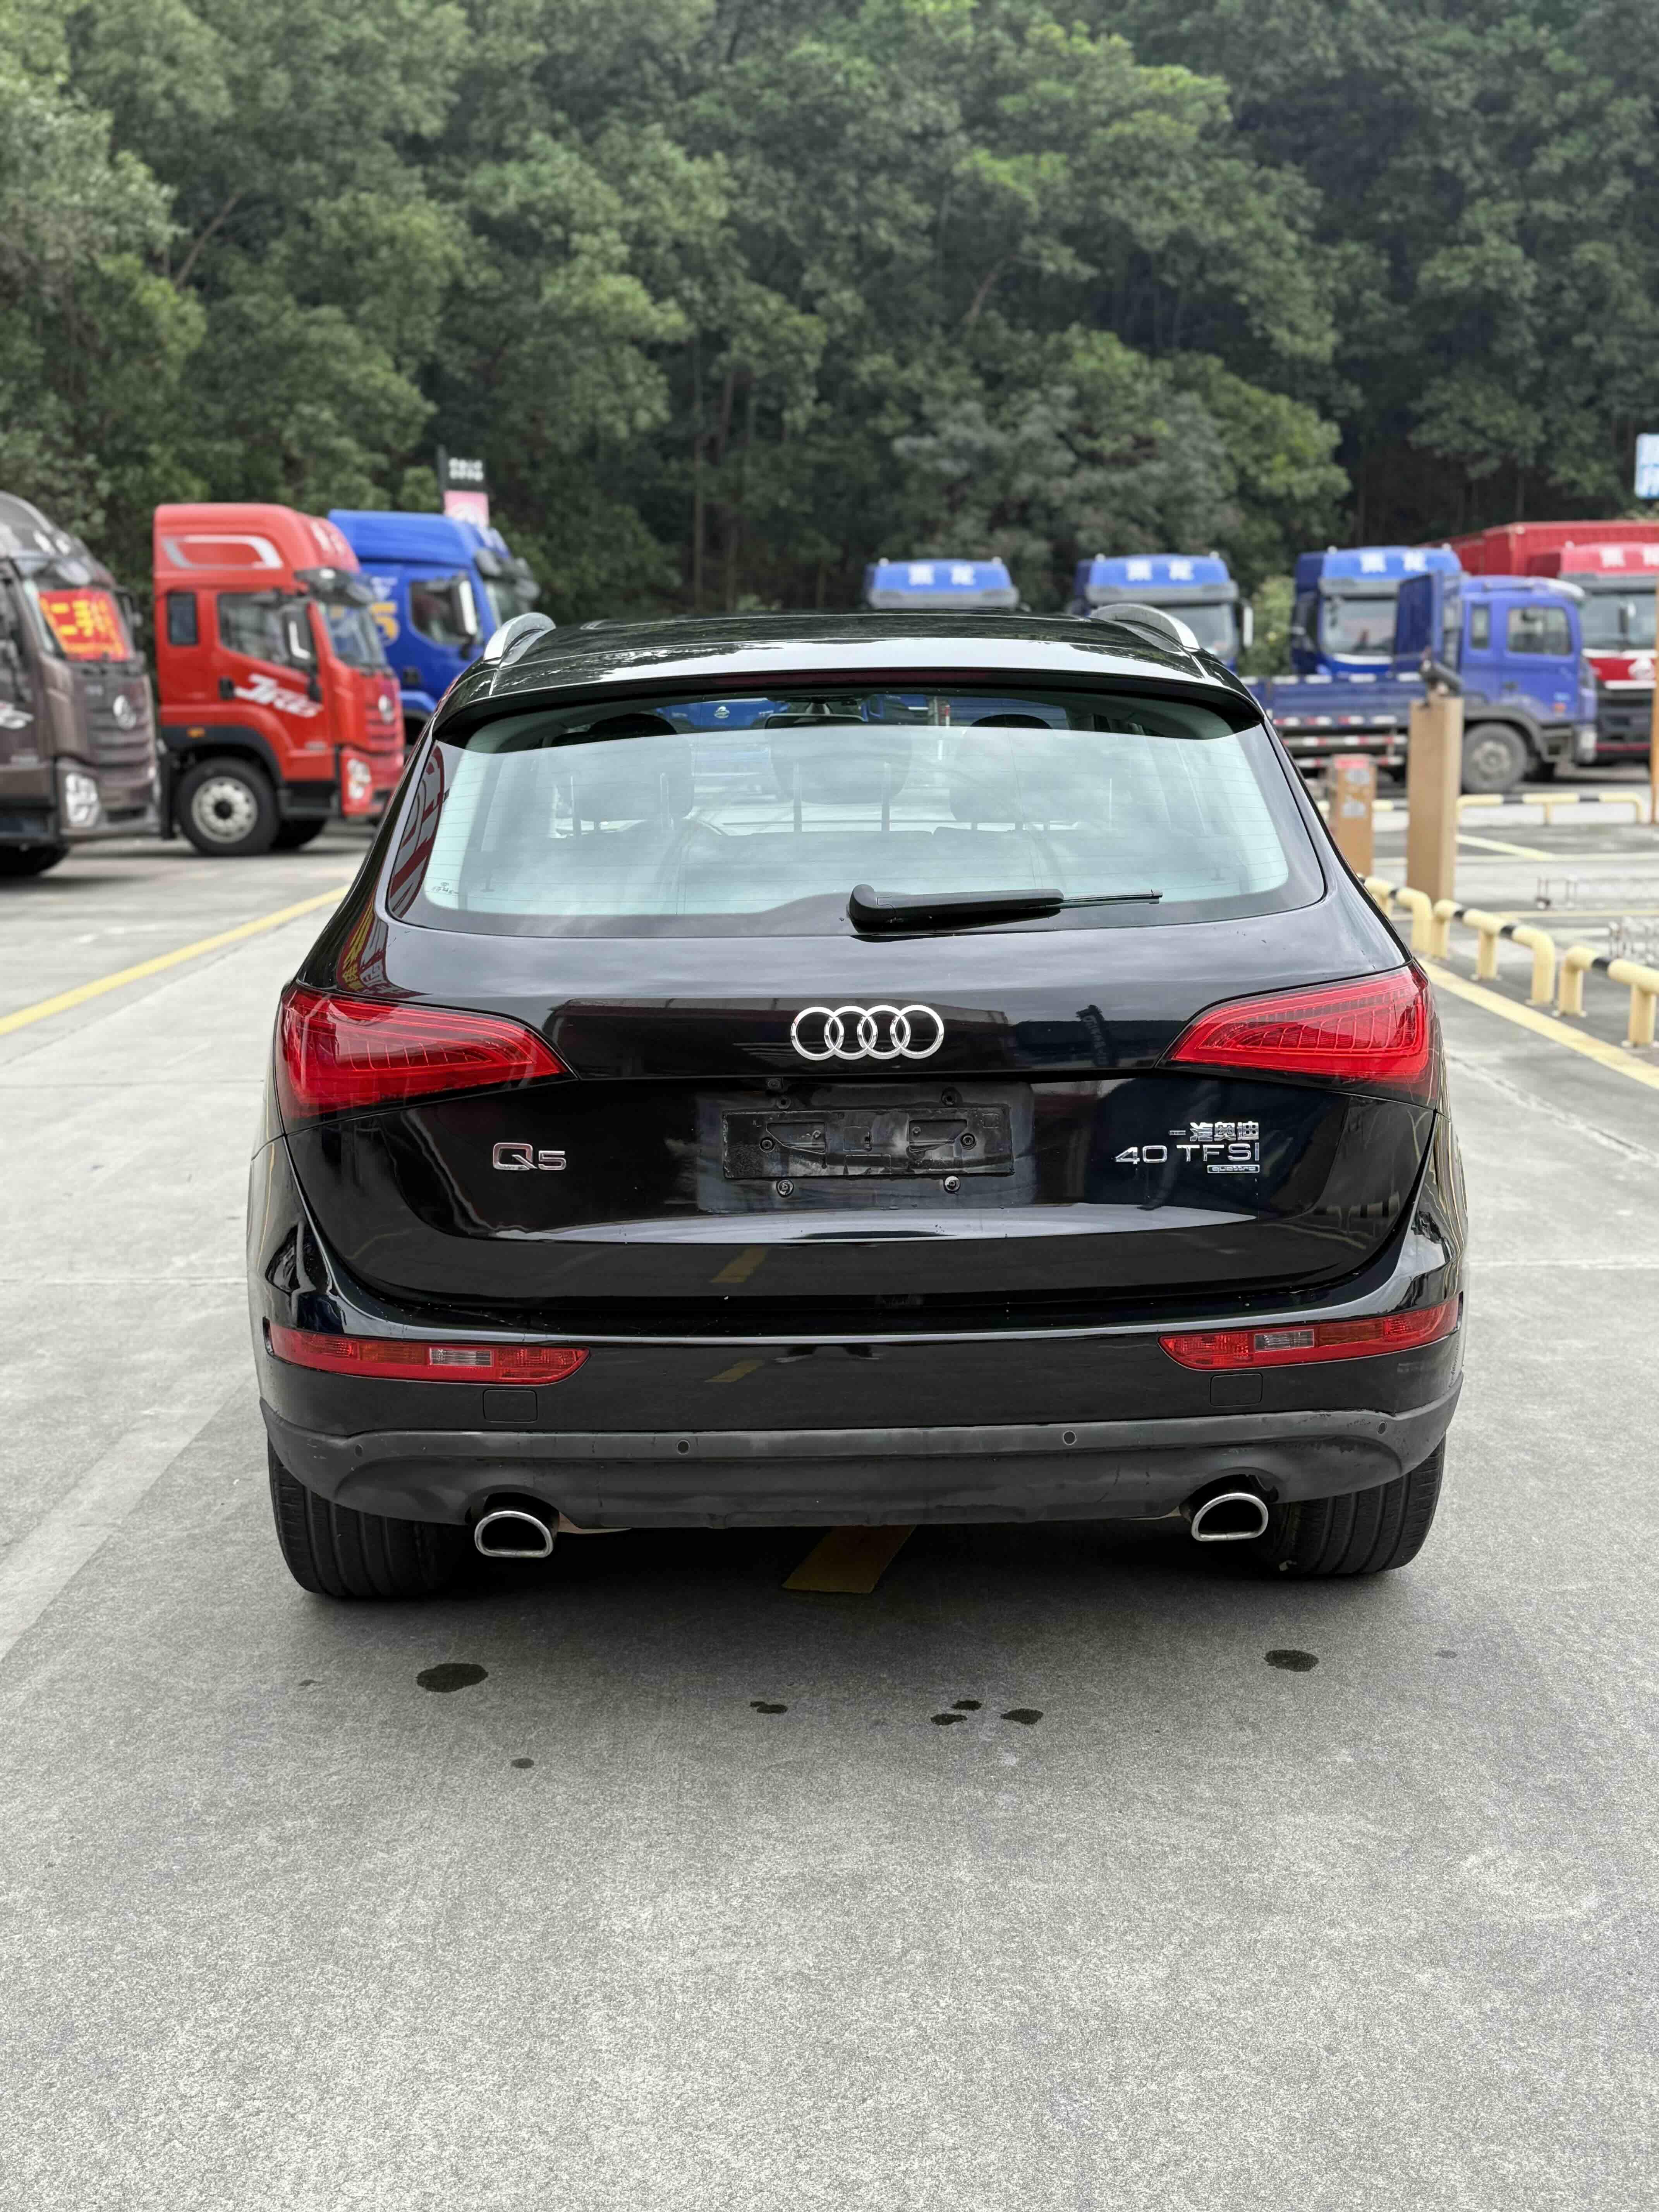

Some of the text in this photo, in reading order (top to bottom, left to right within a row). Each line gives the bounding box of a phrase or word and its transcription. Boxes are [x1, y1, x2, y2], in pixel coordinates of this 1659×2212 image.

[493, 1142, 567, 1171] Q5
[1115, 1142, 1260, 1164] 40 TFSI
